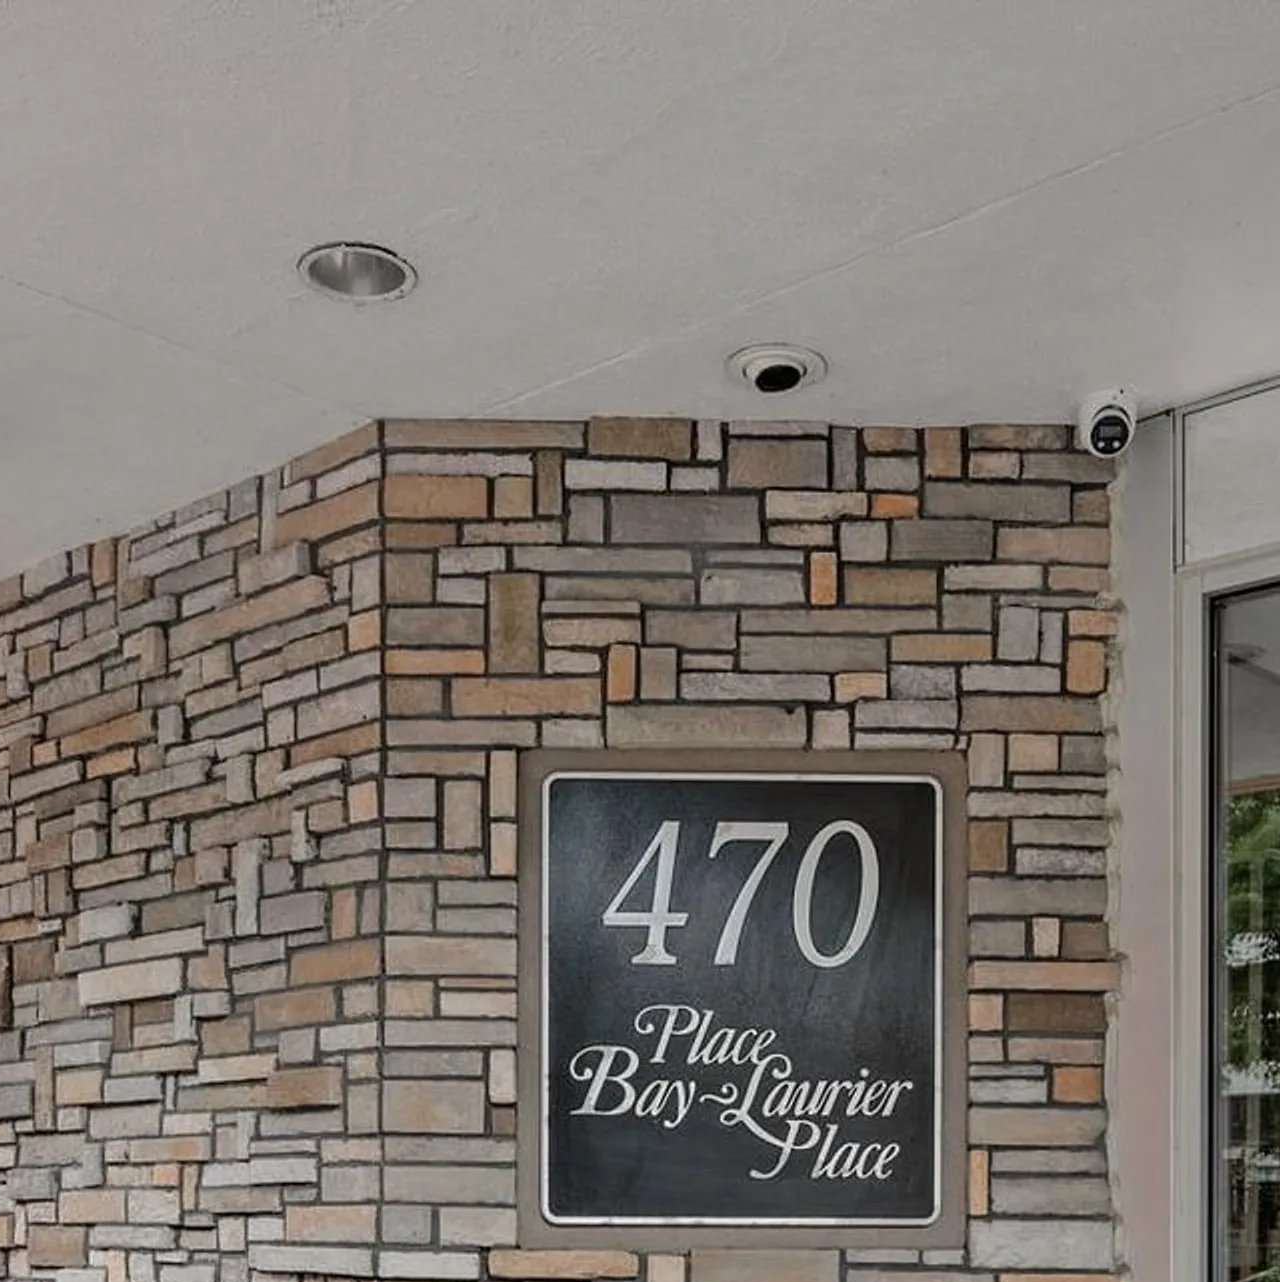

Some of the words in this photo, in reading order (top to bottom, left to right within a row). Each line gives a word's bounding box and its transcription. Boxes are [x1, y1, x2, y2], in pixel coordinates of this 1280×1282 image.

[601, 819, 881, 968] 470
[634, 1004, 777, 1065] Place
[749, 1119, 901, 1180] Place
